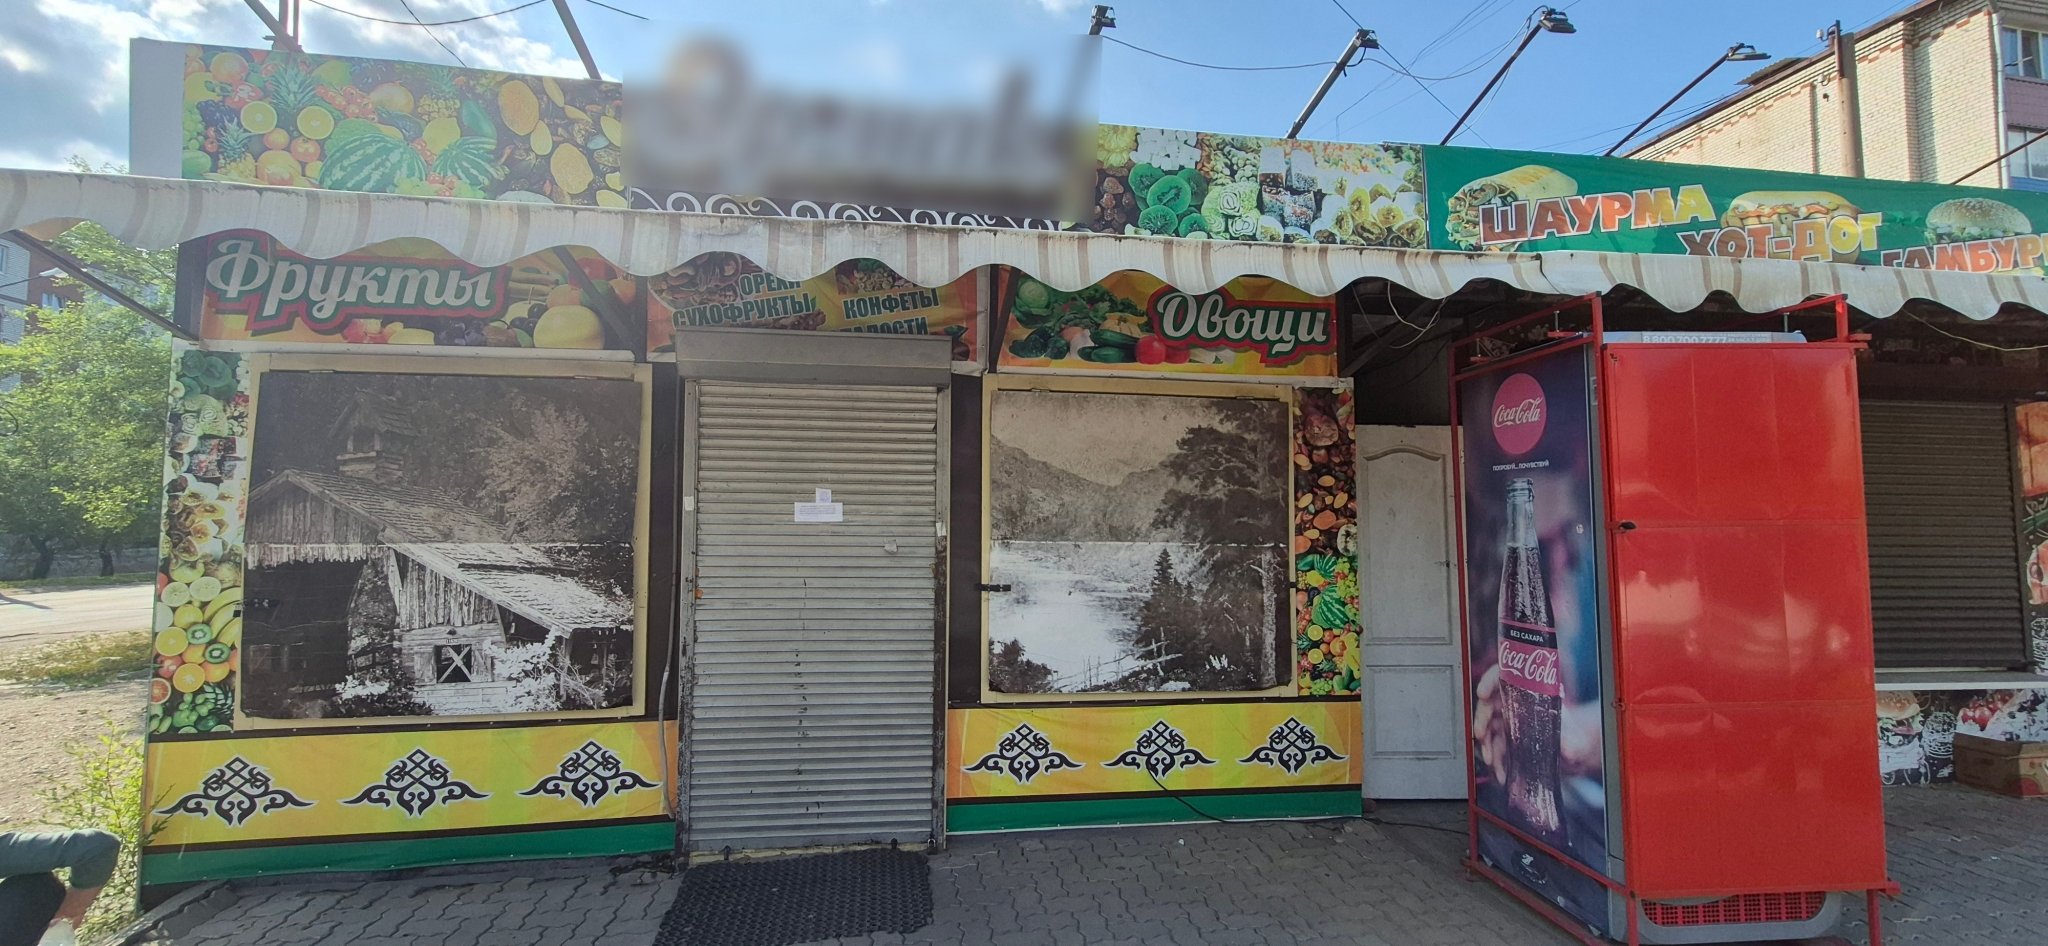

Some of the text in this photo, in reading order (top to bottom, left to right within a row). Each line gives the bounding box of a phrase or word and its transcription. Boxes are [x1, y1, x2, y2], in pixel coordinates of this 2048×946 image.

[1479, 184, 1717, 245] ШАУРМА
[1676, 212, 1883, 262] ХОТ-ДОГ
[206, 239, 492, 319] Фрукты
[673, 292, 812, 327] СУХОФРУКТЫ
[843, 288, 940, 320] КОНФЕТЫ
[1156, 291, 1327, 355] Овощи
[1494, 397, 1543, 428] Coca-Cola
[1510, 629, 1544, 643] БЕЗ САХАРА
[1499, 641, 1558, 685] Coca-Cola
